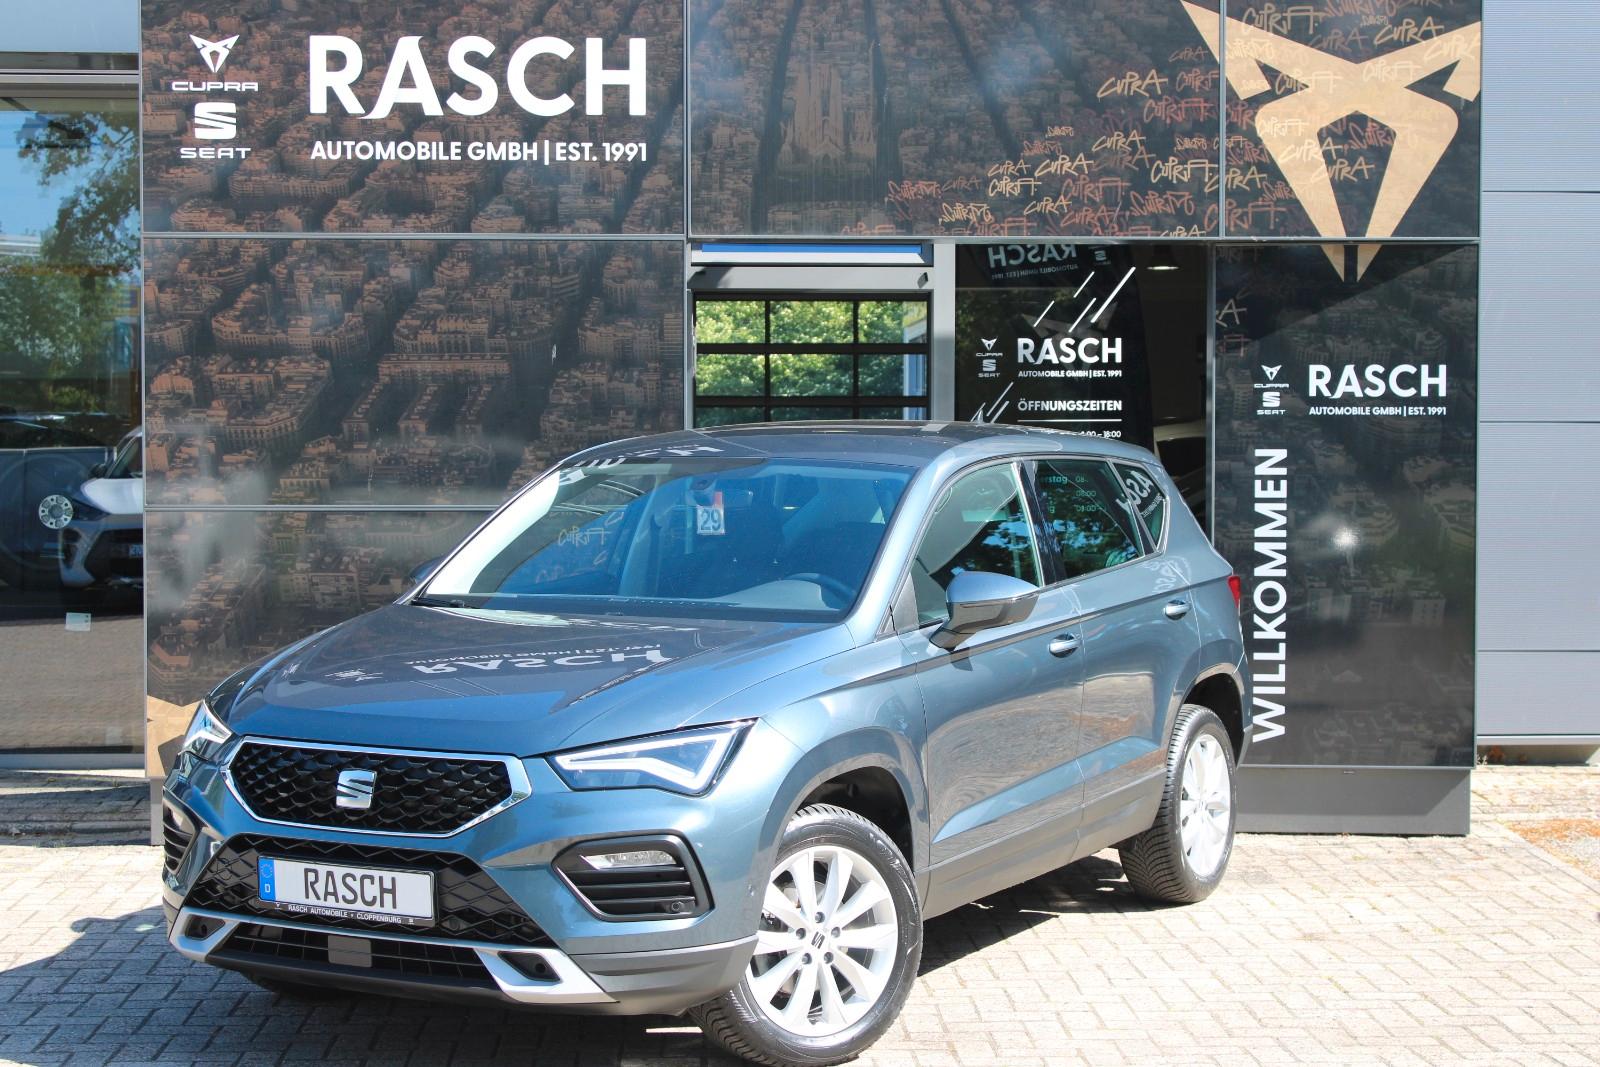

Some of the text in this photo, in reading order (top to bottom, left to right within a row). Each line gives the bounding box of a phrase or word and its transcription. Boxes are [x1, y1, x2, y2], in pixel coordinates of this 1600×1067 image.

[1374, 16, 1444, 46] CUPRA
[172, 82, 258, 91] CUPRA
[309, 35, 646, 119] RASCH
[1097, 69, 1168, 99] CUPRA
[310, 141, 461, 160] AUTOMOBILE
[467, 142, 537, 161] GMBH
[555, 143, 598, 161] EST.
[604, 143, 646, 161] 1991
[1092, 129, 1146, 151] CUPRA
[180, 148, 251, 158] SEAT
[988, 159, 1031, 177] CUPRA
[1034, 152, 1094, 177] CUPRA
[1311, 156, 1375, 184] CUPRA
[1024, 194, 1072, 215] CUPRA
[1017, 338, 1122, 365] RASCH
[1018, 370, 1065, 378] AUTOMOBILE
[1067, 370, 1088, 378] GMBH
[1093, 370, 1106, 378] EST.
[1108, 370, 1122, 378] 1991
[1309, 364, 1447, 399] RASCH
[1018, 398, 1122, 411] ÖFFNUNGSZEITEN
[1309, 407, 1371, 416] AUTOMOBILE
[1373, 407, 1401, 416] GMBH
[1408, 407, 1427, 416] EST.
[1428, 407, 1446, 416] 1991
[700, 509, 721, 531] 29
[1252, 448, 1288, 743] WILLKOMMEN
[264, 884, 271, 893] D
[304, 867, 398, 909] RASCH
[288, 904, 402, 924] RASCH AUTOMOBILE CLOPPENBURG
